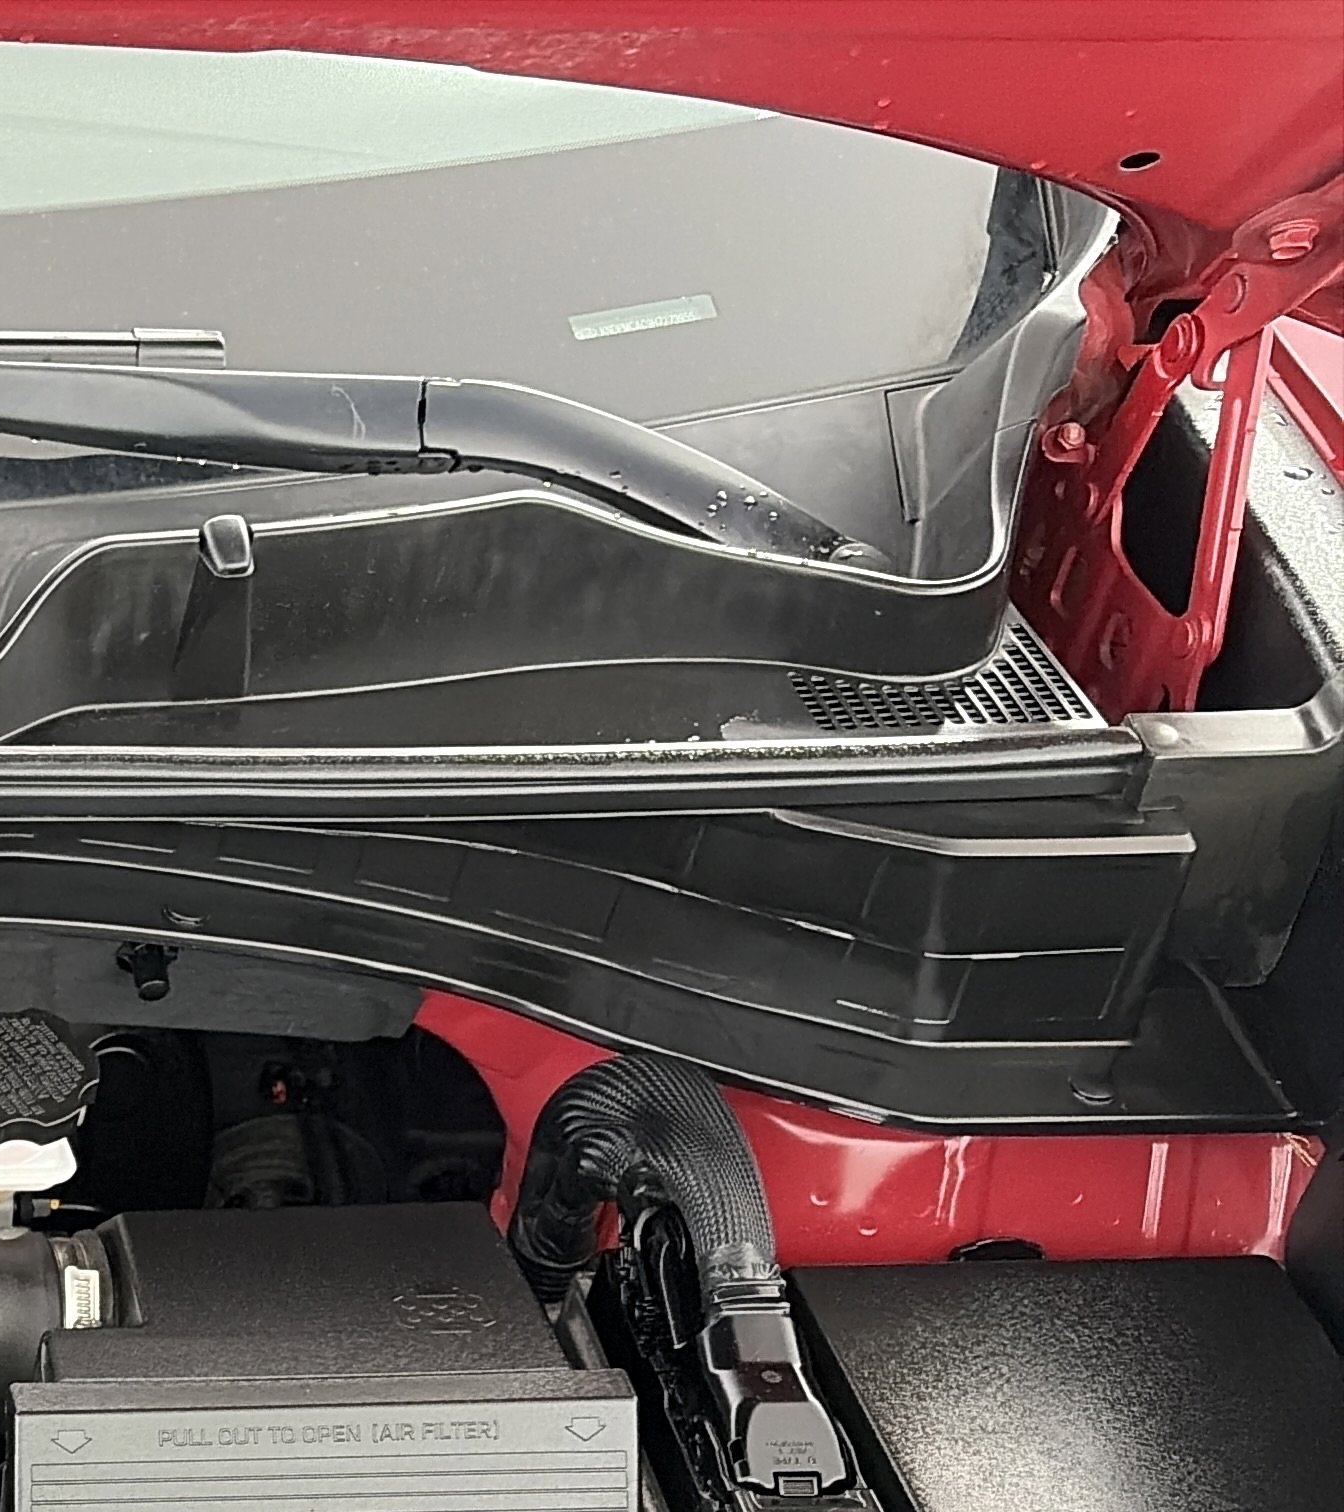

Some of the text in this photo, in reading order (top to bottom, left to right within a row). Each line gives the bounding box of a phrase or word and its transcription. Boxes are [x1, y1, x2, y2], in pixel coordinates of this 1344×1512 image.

[157, 1427, 213, 1448] PULL
[217, 1425, 262, 1447] OUT
[267, 1424, 296, 1445] TO
[301, 1422, 362, 1444] OPEN
